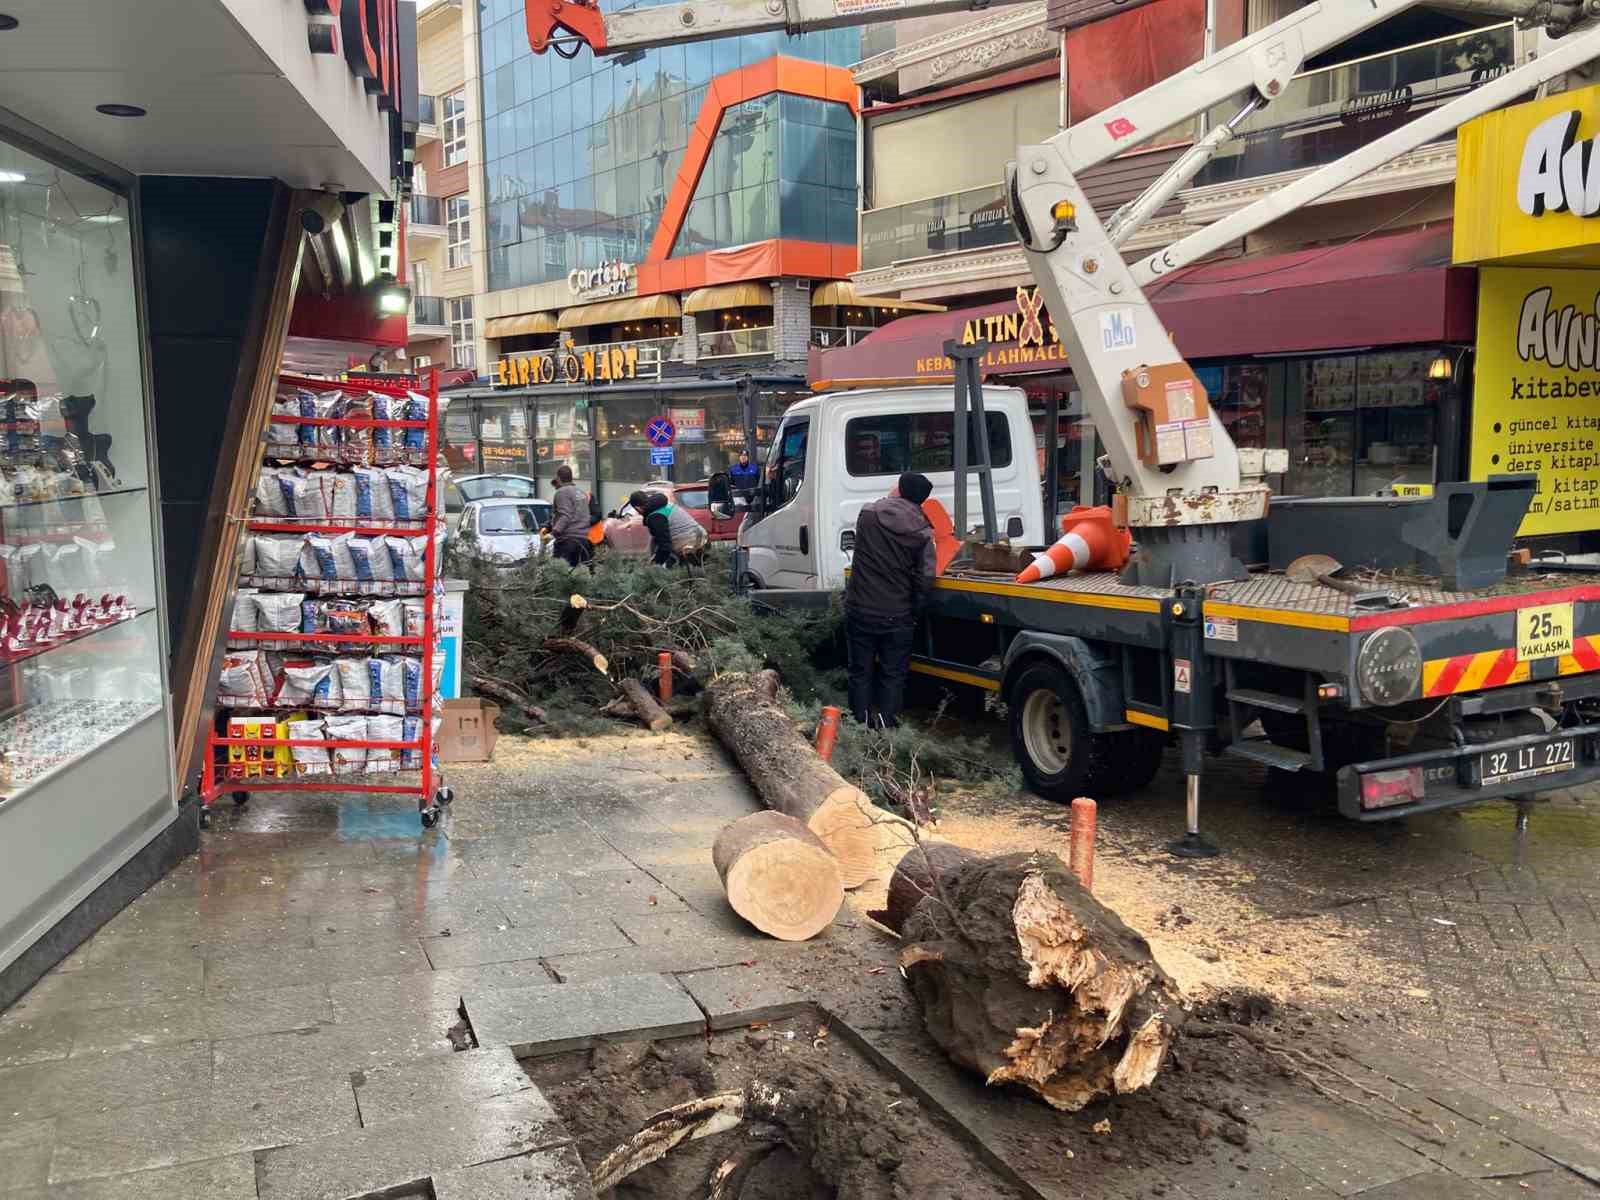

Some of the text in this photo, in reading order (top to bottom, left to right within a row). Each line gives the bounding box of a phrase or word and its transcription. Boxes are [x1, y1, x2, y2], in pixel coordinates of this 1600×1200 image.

[600, 343, 638, 381] ART
[916, 356, 956, 373] KEBA
[1509, 415, 1557, 436] güncel
[1508, 437, 1594, 456] üniversite
[1507, 458, 1542, 472] ders
[1490, 741, 1570, 775] 32 LT 272
